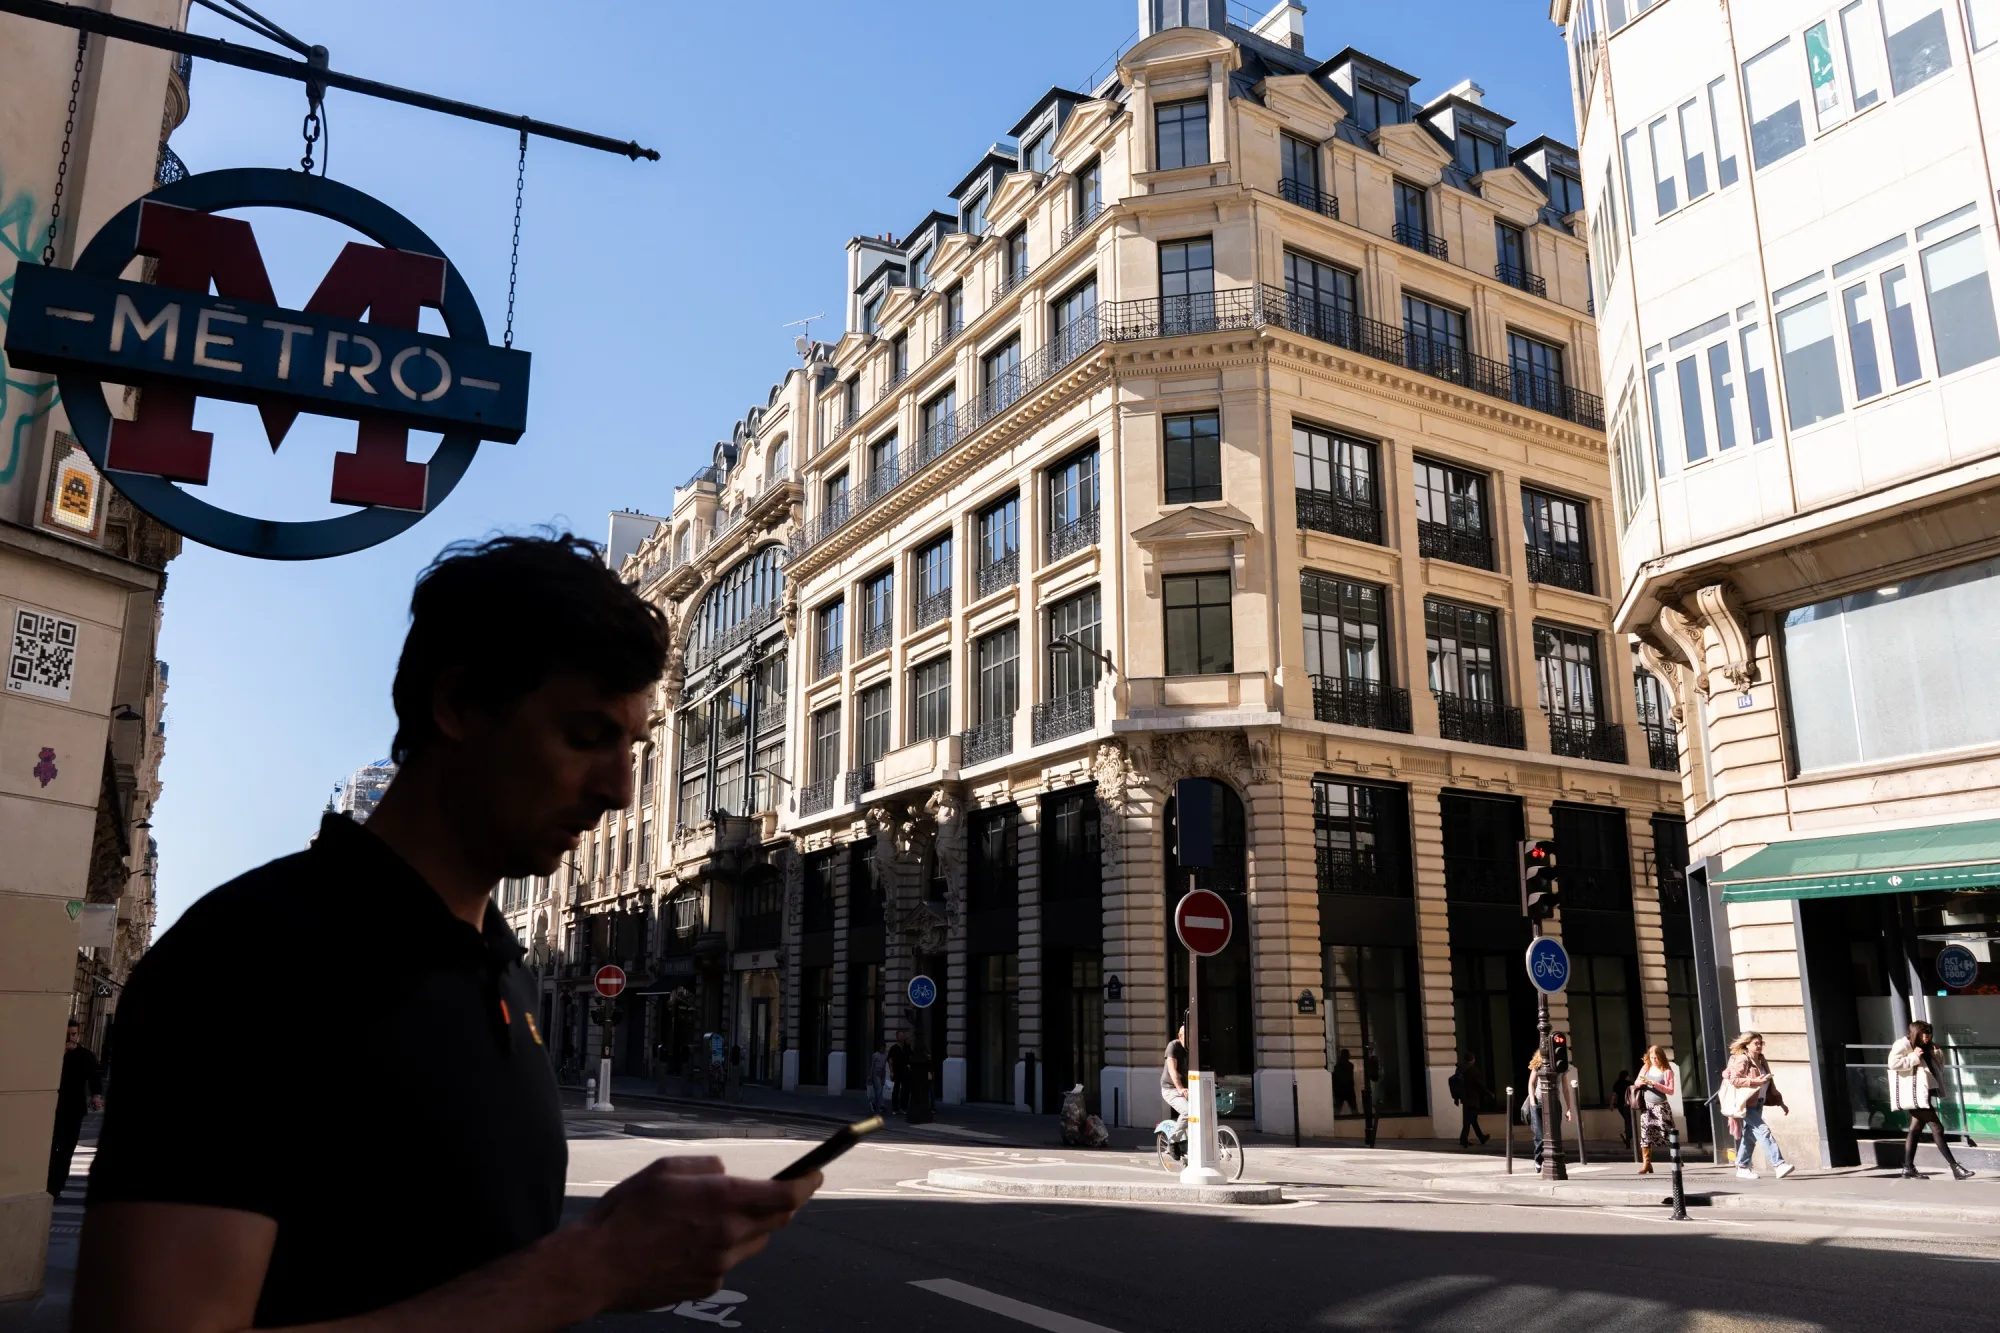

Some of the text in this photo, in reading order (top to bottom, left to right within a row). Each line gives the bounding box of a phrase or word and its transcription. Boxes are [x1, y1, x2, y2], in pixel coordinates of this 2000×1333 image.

[104, 199, 447, 513] M
[1944, 957, 1958, 965] ACT
[1945, 964, 1959, 972] FOR
[1945, 970, 1966, 978] FOOD
